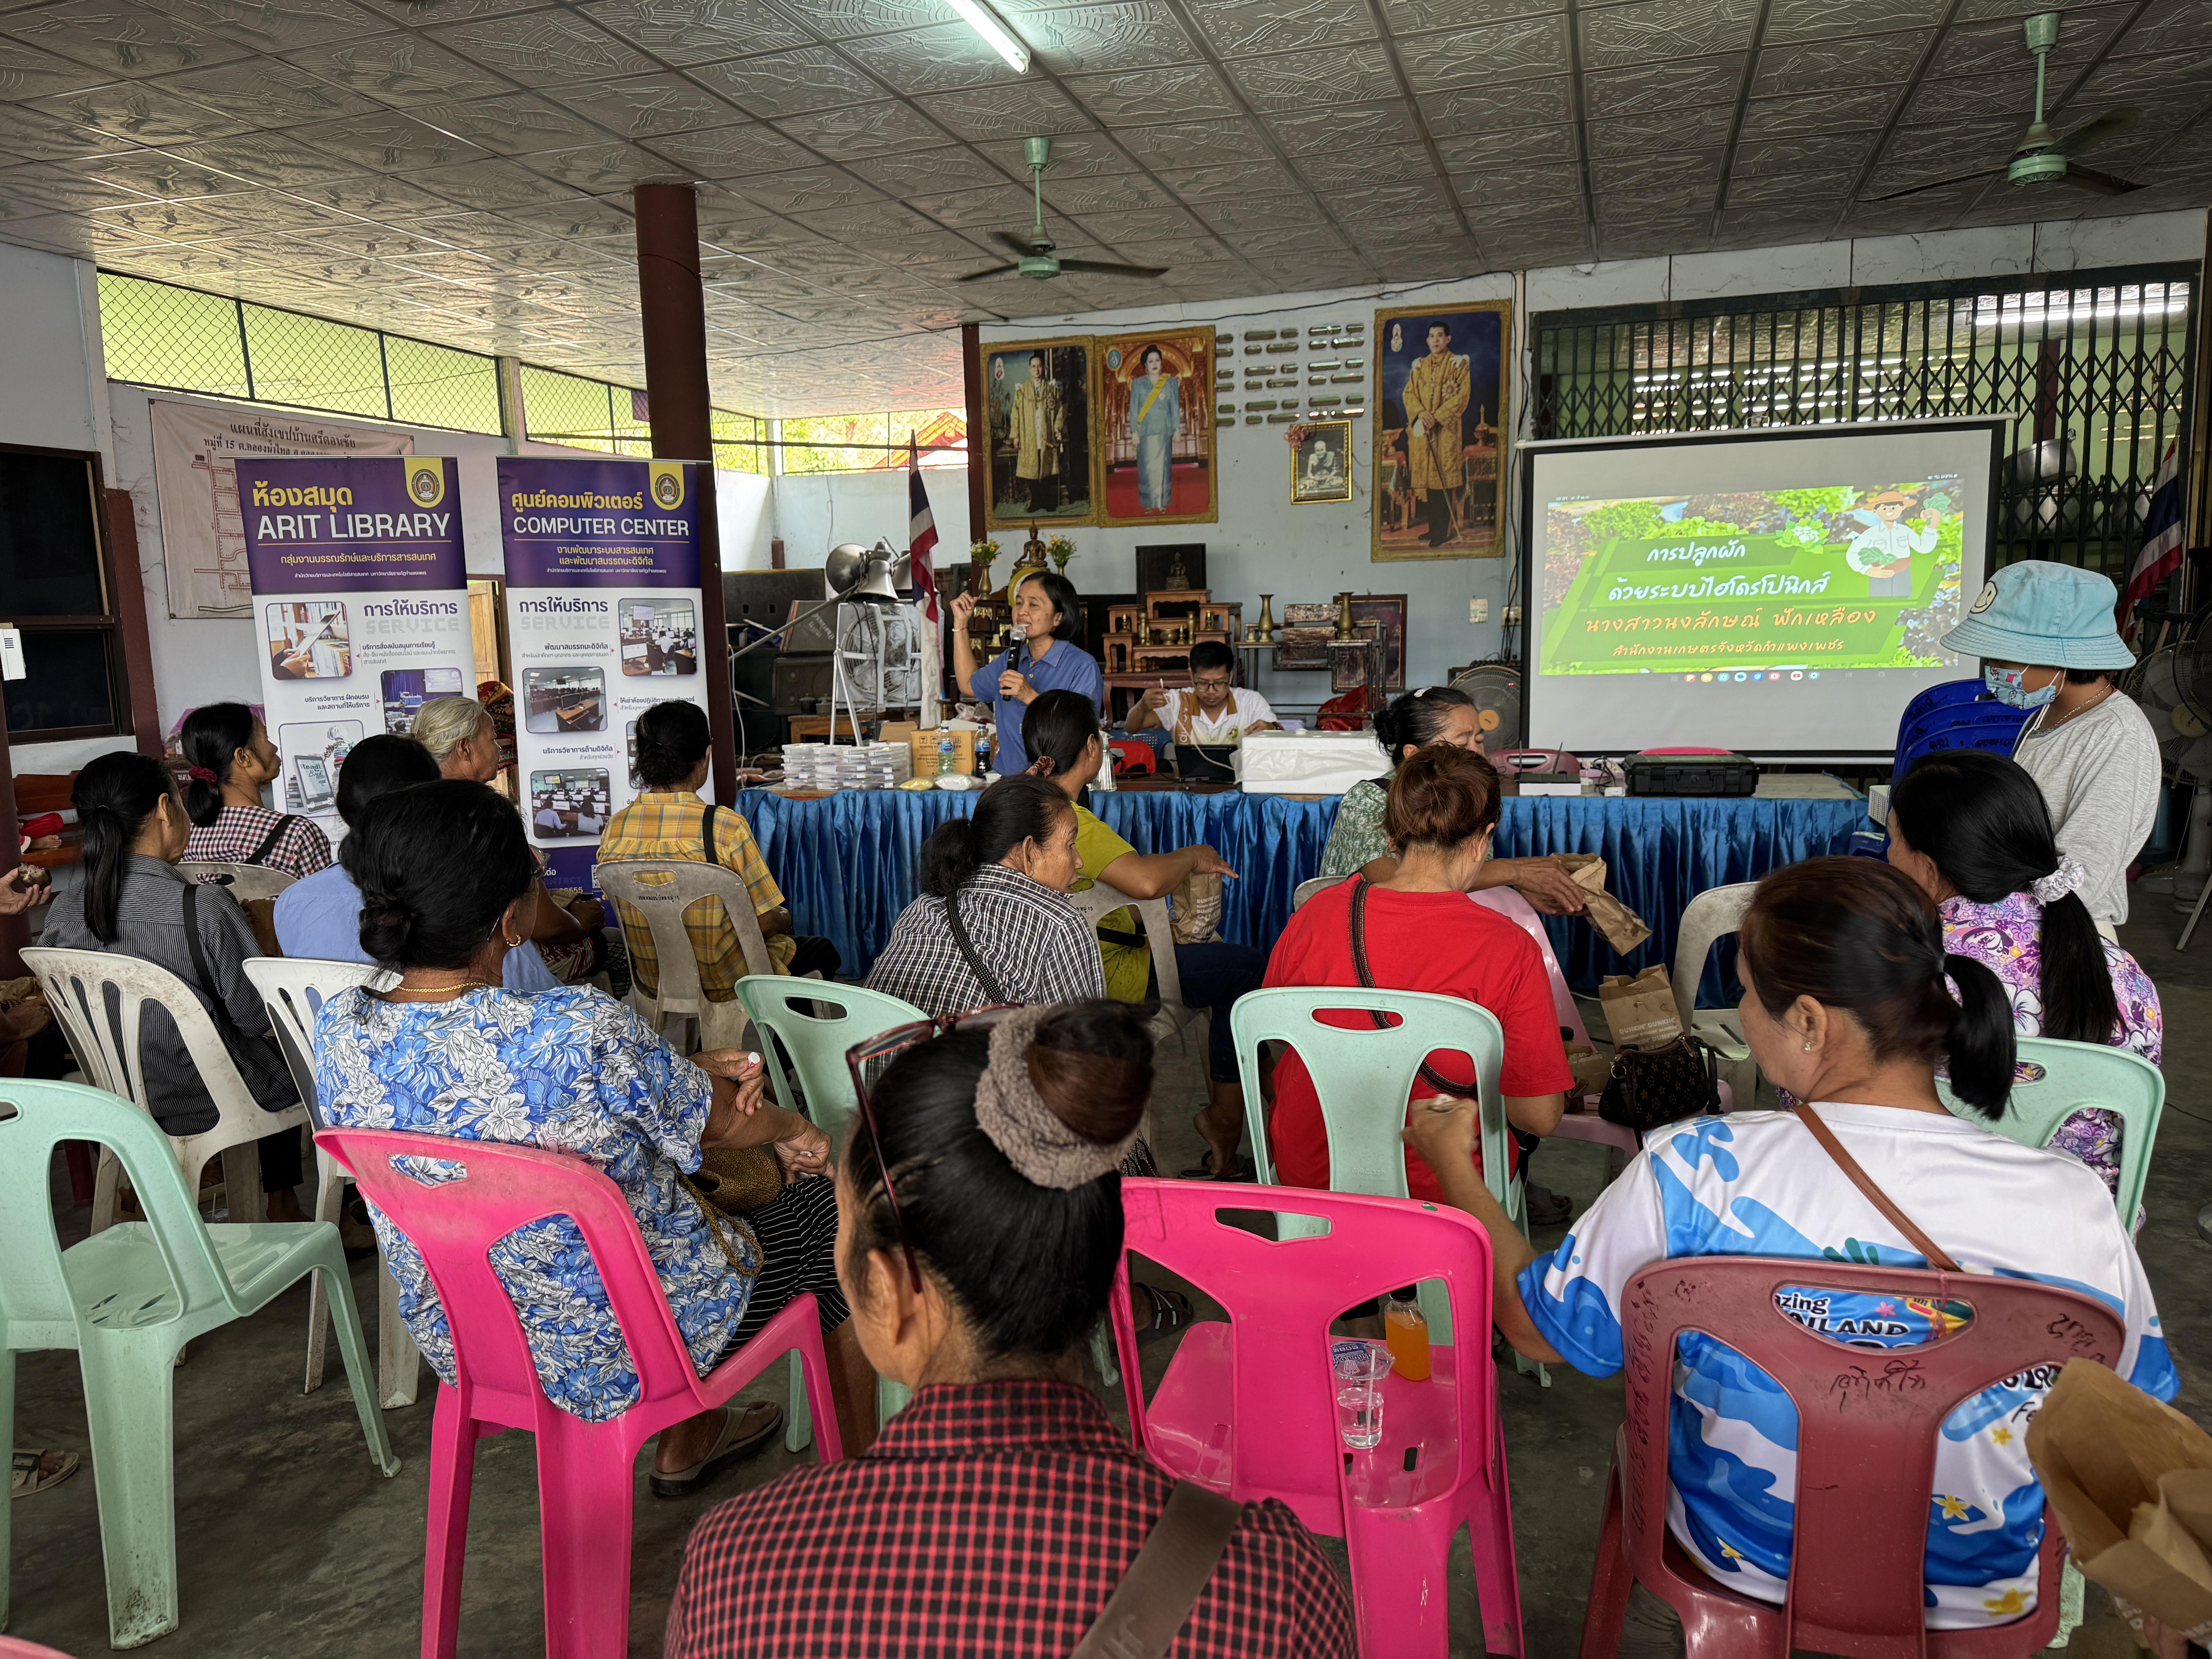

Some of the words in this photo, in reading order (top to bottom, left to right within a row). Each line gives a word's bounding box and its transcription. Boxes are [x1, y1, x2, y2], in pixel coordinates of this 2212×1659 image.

[230, 417, 356, 448] แผนที่สังเขปบ้านศรีดอนชัย
[204, 434, 222, 452] หมู่ที่
[226, 440, 235, 449] 15
[252, 481, 352, 513] ห้องสมุด
[512, 489, 643, 512] ศูนย์คอมพิวเตอร์
[258, 515, 321, 539] ARIT
[330, 513, 450, 538] LIBRARY
[514, 517, 615, 534] COMPUTER
[621, 518, 689, 536] CENTER
[557, 545, 654, 555] งานพัฒนาระบบสารสนเทศ
[1647, 539, 1746, 567] การปลูกผัก
[281, 553, 436, 566] กลุ่มงานบรรณรักษ์และบริการสารสนเทศ
[559, 556, 653, 565] และพัฒนาสมรรถนะดิจิทัล
[1608, 571, 1831, 601] ด้วยระบบไฮโดรโปนิกส์
[364, 599, 458, 616] การให้บริการ
[520, 596, 608, 612] การให้บริการ
[366, 617, 460, 634] SERVICE
[521, 616, 610, 630] SERVICE
[1586, 608, 1763, 632] นางสาวนงลักษณ์
[1773, 606, 1876, 627] ฟักเหลือง
[362, 641, 435, 650] บริการสิ่งสนับสนุนการเรียนรู้
[1613, 638, 1844, 656] สำนักงานเกษตรจังหวัดกำแพงเพชร
[543, 745, 613, 754] บริการวิชาการด้านดิจิทัล
[544, 877, 581, 885] ONTACT
[1619, 1024, 1646, 1034] DUNKIN'
[1647, 1017, 1676, 1028] DUNKIN'
[1775, 1293, 1828, 1315] azing
[1787, 1312, 1908, 1335] AILAND
